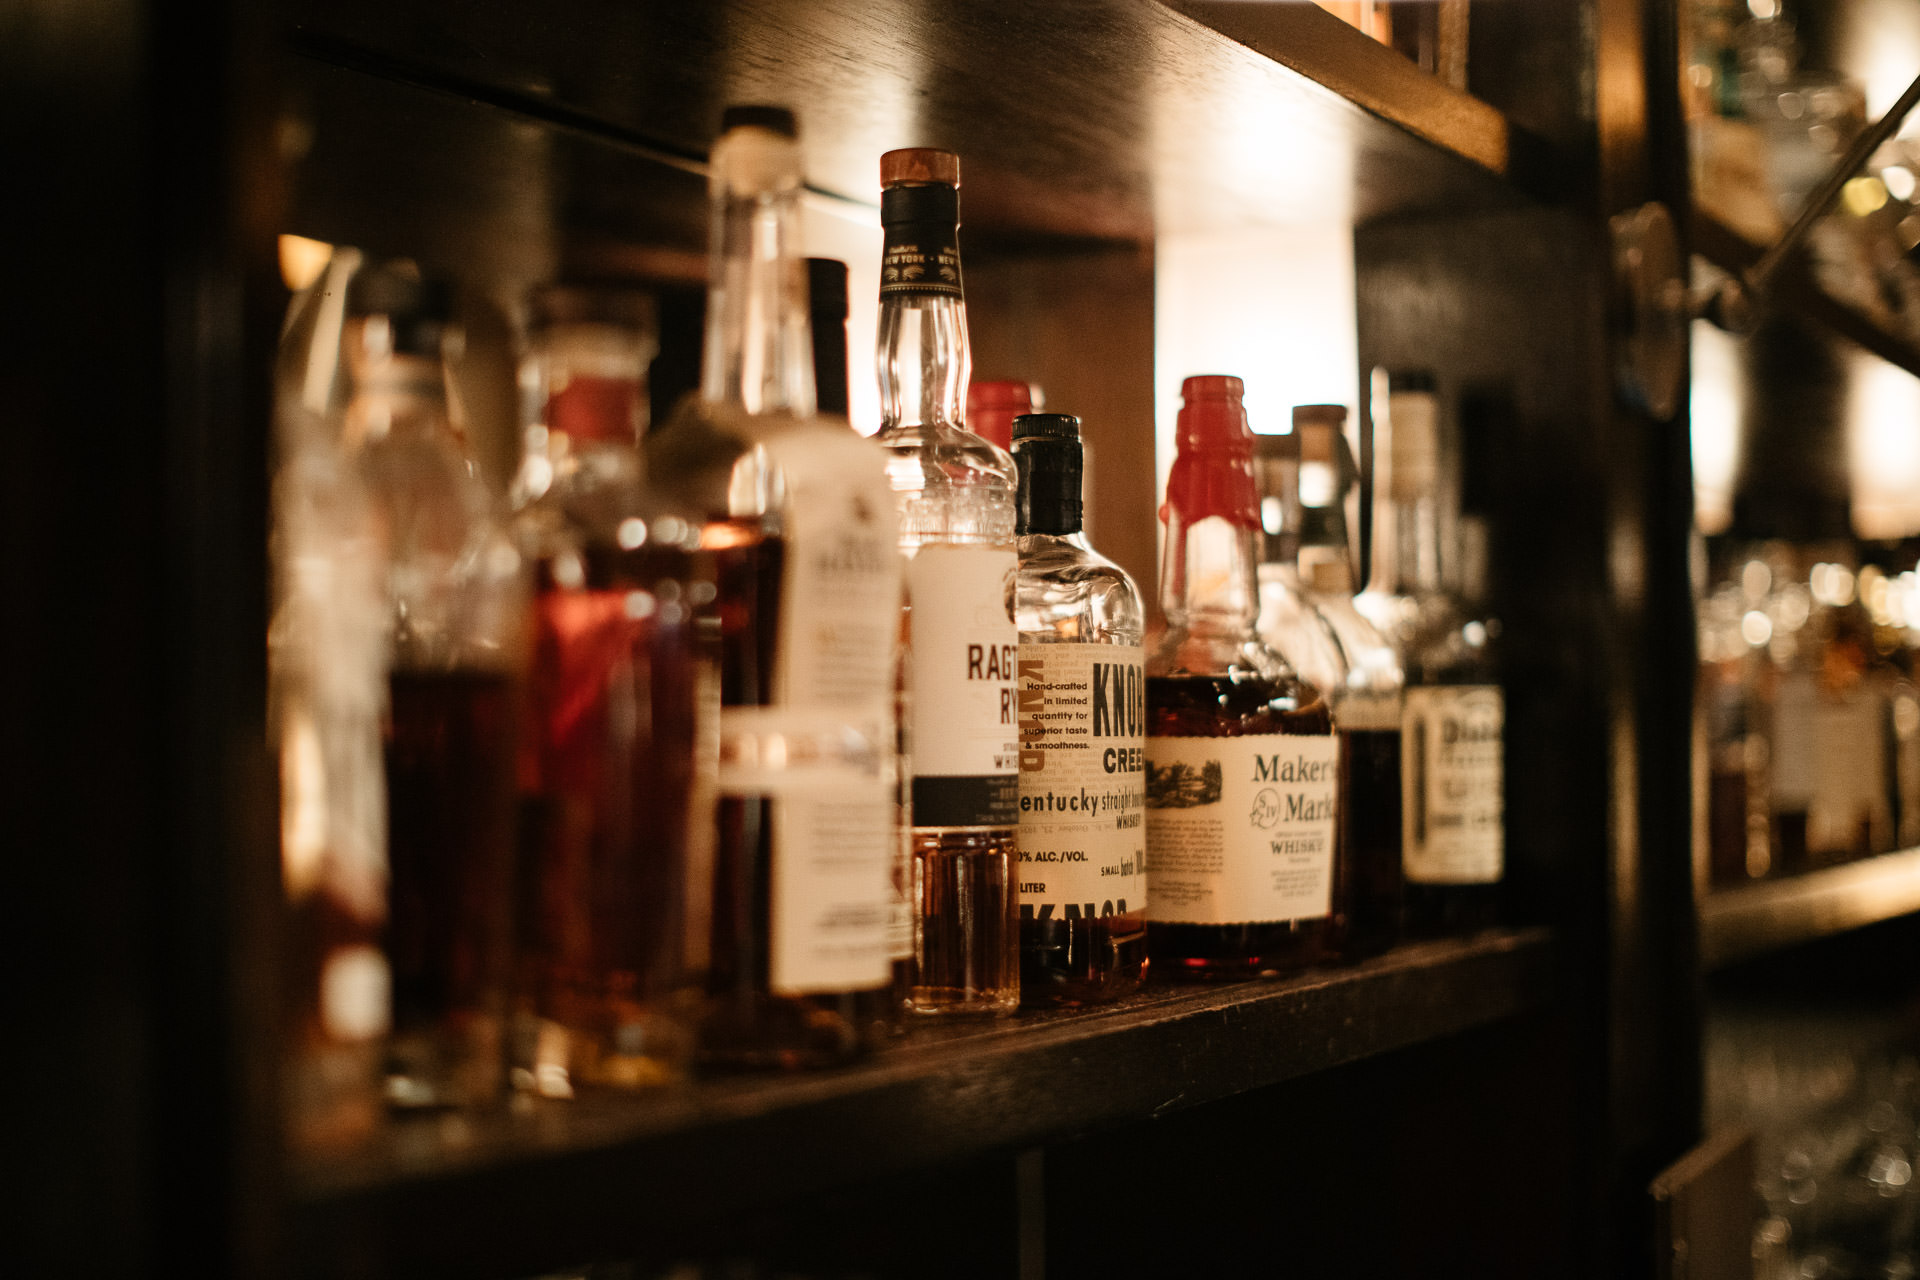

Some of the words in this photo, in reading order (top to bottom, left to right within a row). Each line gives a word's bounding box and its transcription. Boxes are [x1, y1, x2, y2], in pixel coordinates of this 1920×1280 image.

[902, 255, 925, 263] YORK
[1027, 683, 1088, 691] Hand-crafted
[1043, 697, 1053, 705] in
[1056, 697, 1088, 705] limited
[1093, 663, 1143, 737] KNOB
[1031, 712, 1073, 720] quantity
[1076, 712, 1088, 720] for
[1024, 727, 1063, 736] superior
[1065, 727, 1088, 735] taste
[1025, 741, 1032, 749] &
[1035, 742, 1090, 750] smoothness.
[1101, 786, 1131, 814] straight
[1283, 793, 1333, 823] Mark
[1270, 839, 1325, 855] WHISKY
[1035, 851, 1089, 863] ALC./VOL.
[1101, 865, 1120, 877] SMALL
[1020, 883, 1046, 893] LITER
